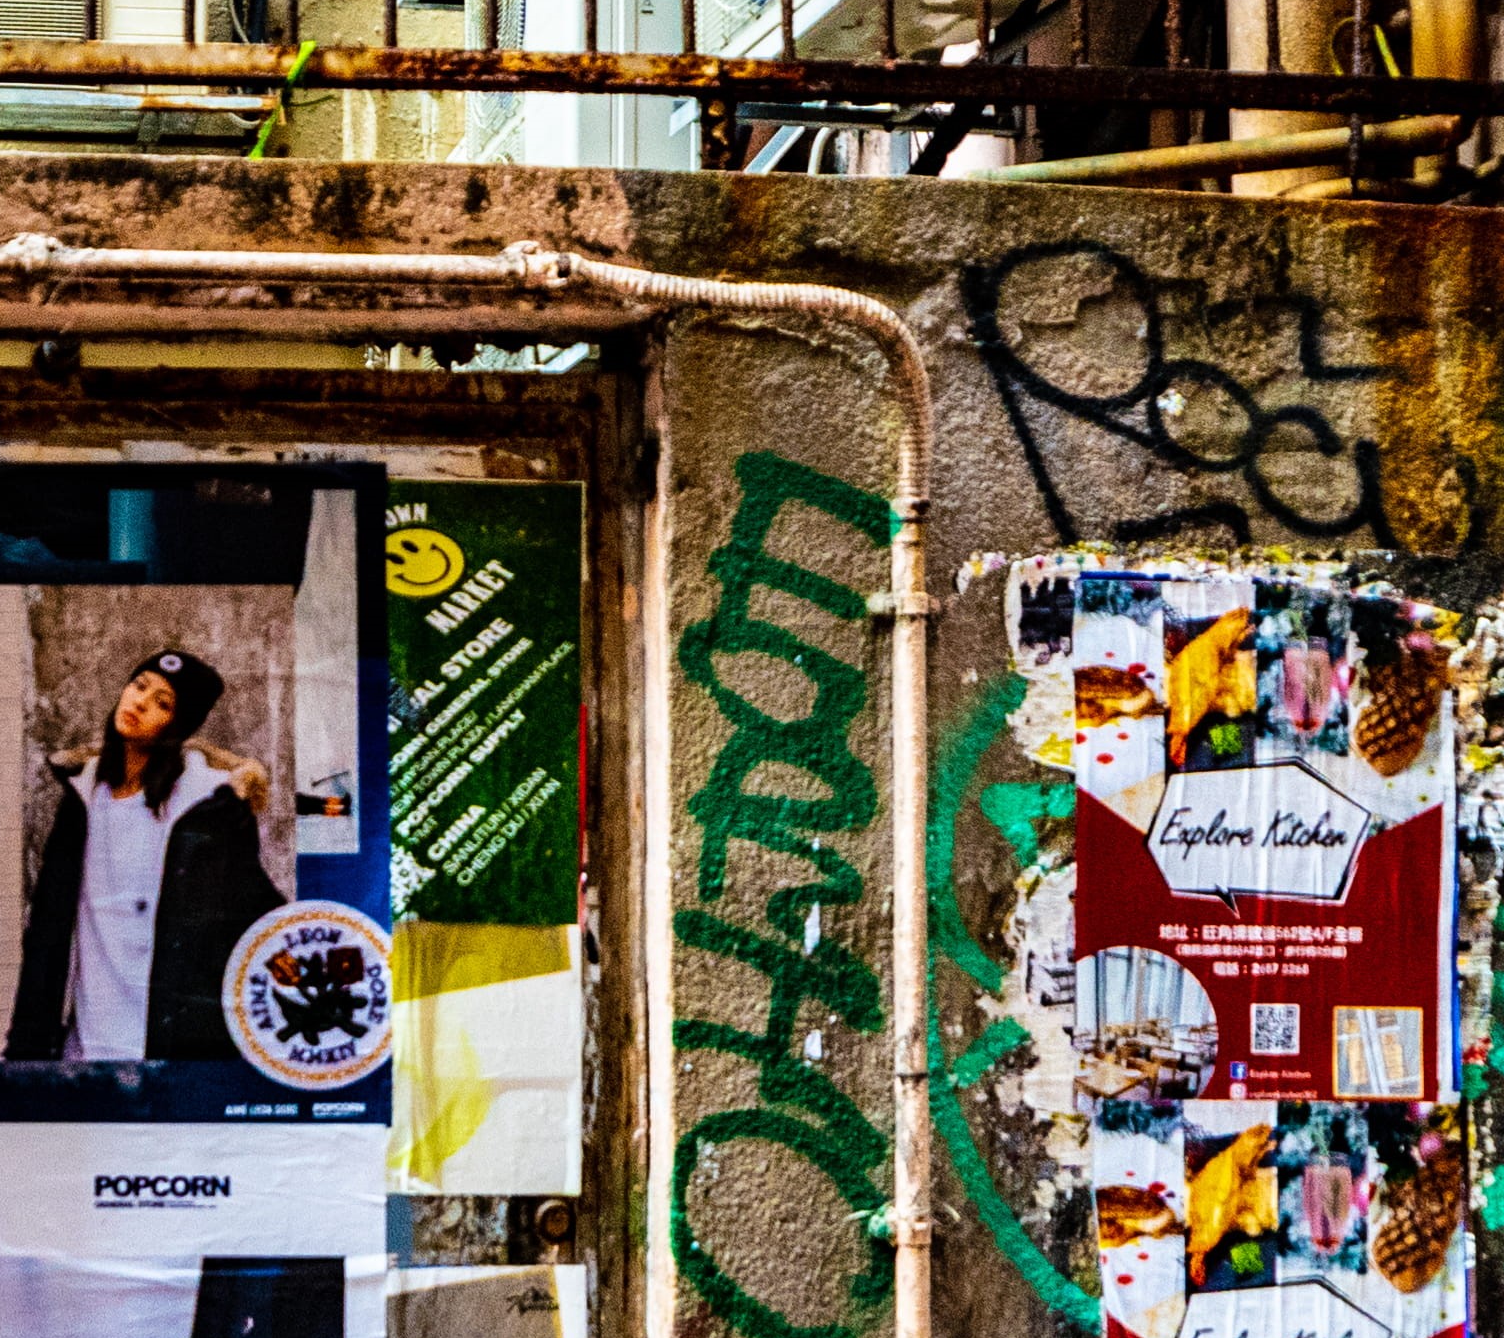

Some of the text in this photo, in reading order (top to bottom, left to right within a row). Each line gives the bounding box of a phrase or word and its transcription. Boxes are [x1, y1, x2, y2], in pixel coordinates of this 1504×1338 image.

[425, 559, 515, 635] MARKET
[440, 617, 514, 680] STORE
[425, 678, 492, 737] GENERAL
[488, 637, 533, 678] STORE
[396, 709, 526, 837] POPCORN SUPPLY
[428, 804, 487, 861] CHINA
[457, 834, 507, 887] CHENG
[1158, 811, 1350, 856] Explore Kitchen
[284, 927, 343, 948] LEON
[94, 1175, 231, 1198] POPCORN
